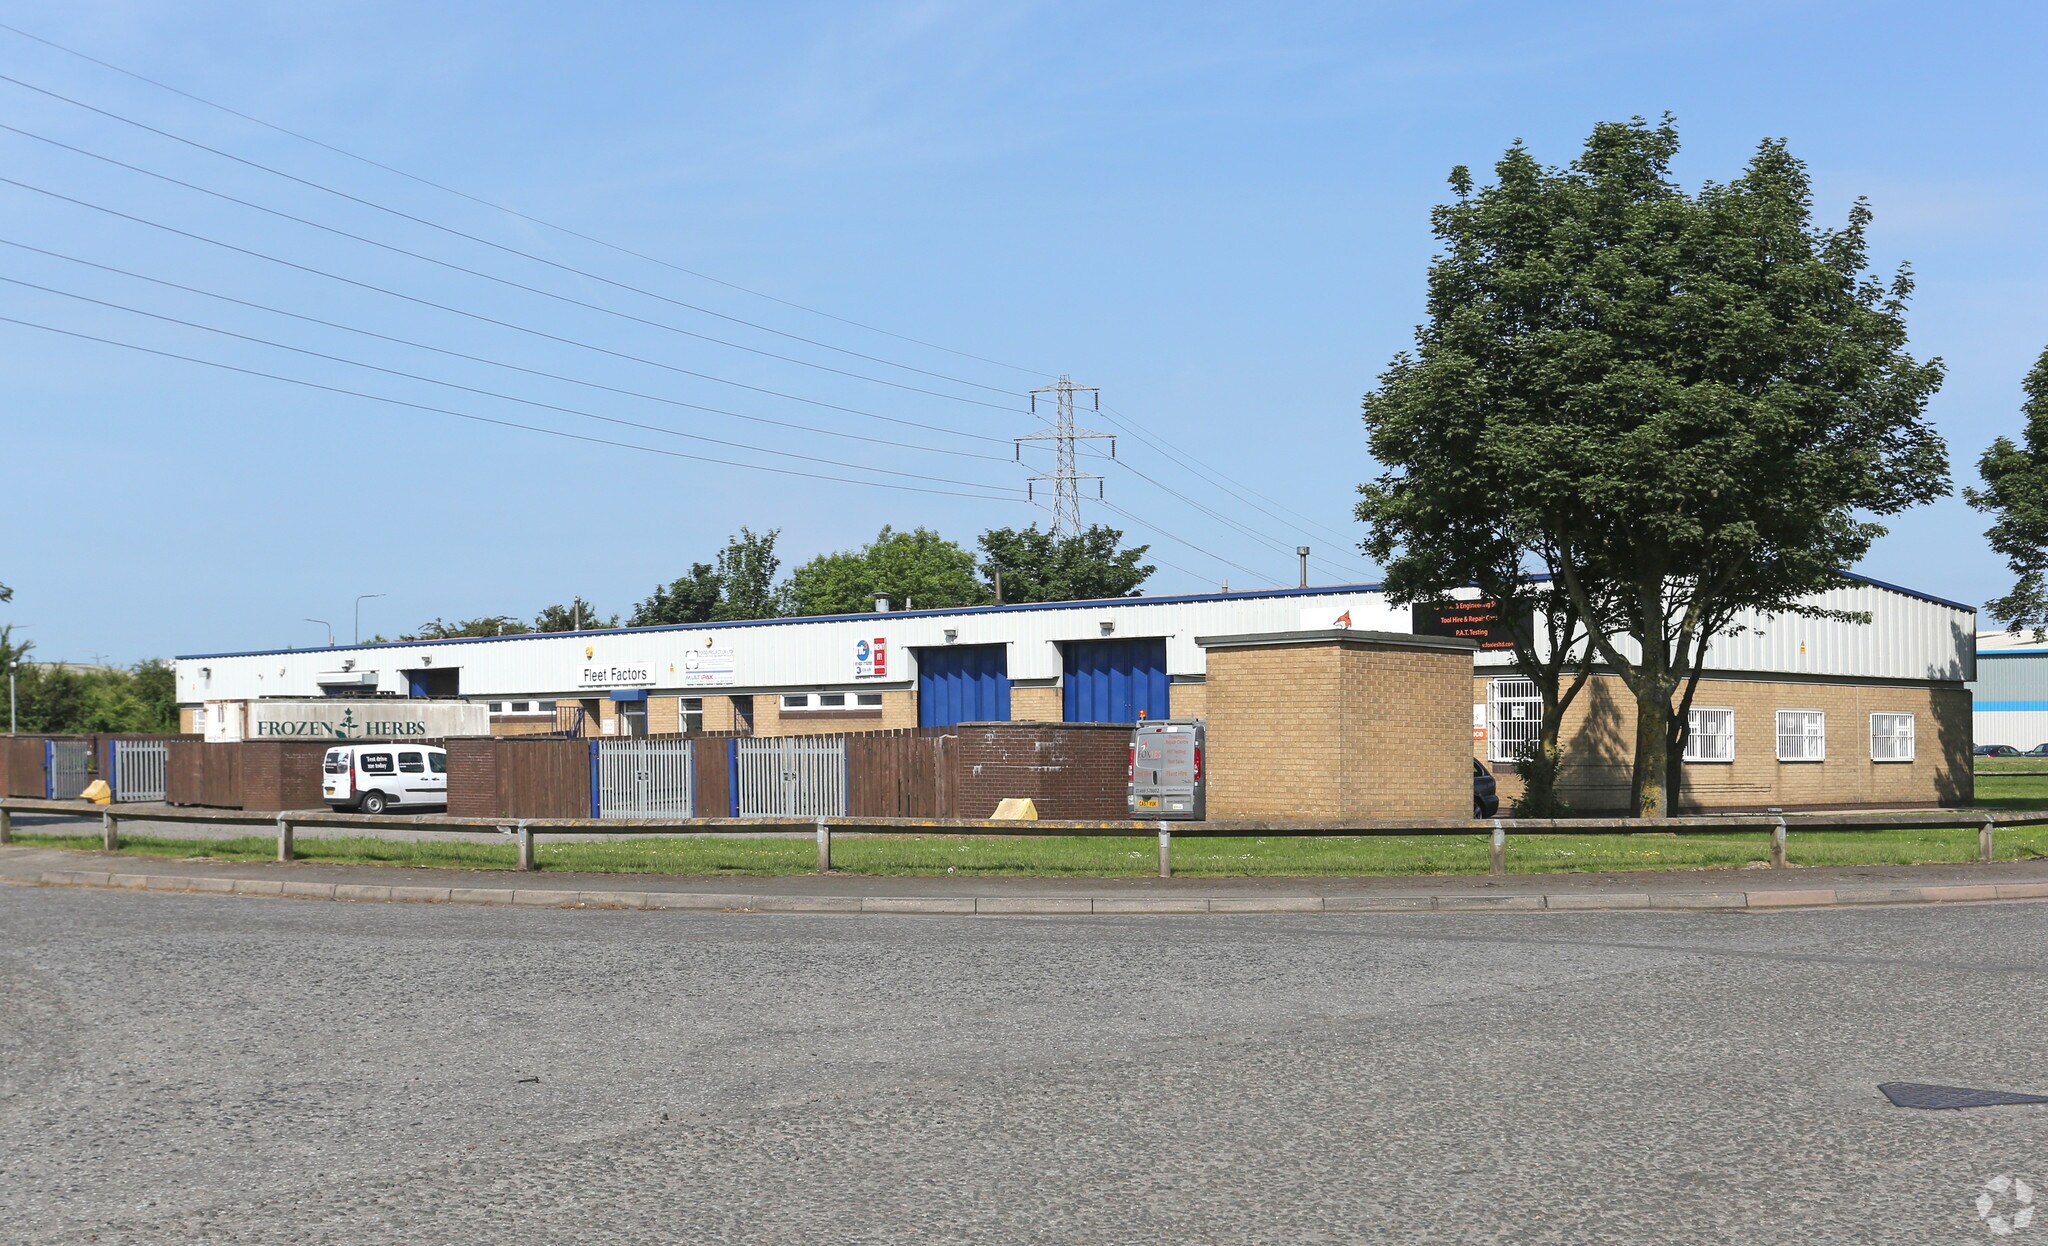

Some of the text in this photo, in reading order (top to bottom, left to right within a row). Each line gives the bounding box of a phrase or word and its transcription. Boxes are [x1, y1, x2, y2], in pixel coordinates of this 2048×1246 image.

[1470, 629, 1488, 637] Testing
[584, 667, 647, 682] Fleet Factors
[258, 720, 426, 736] FROZEN HERBS
[376, 755, 388, 763] drive
[375, 762, 387, 770] today
